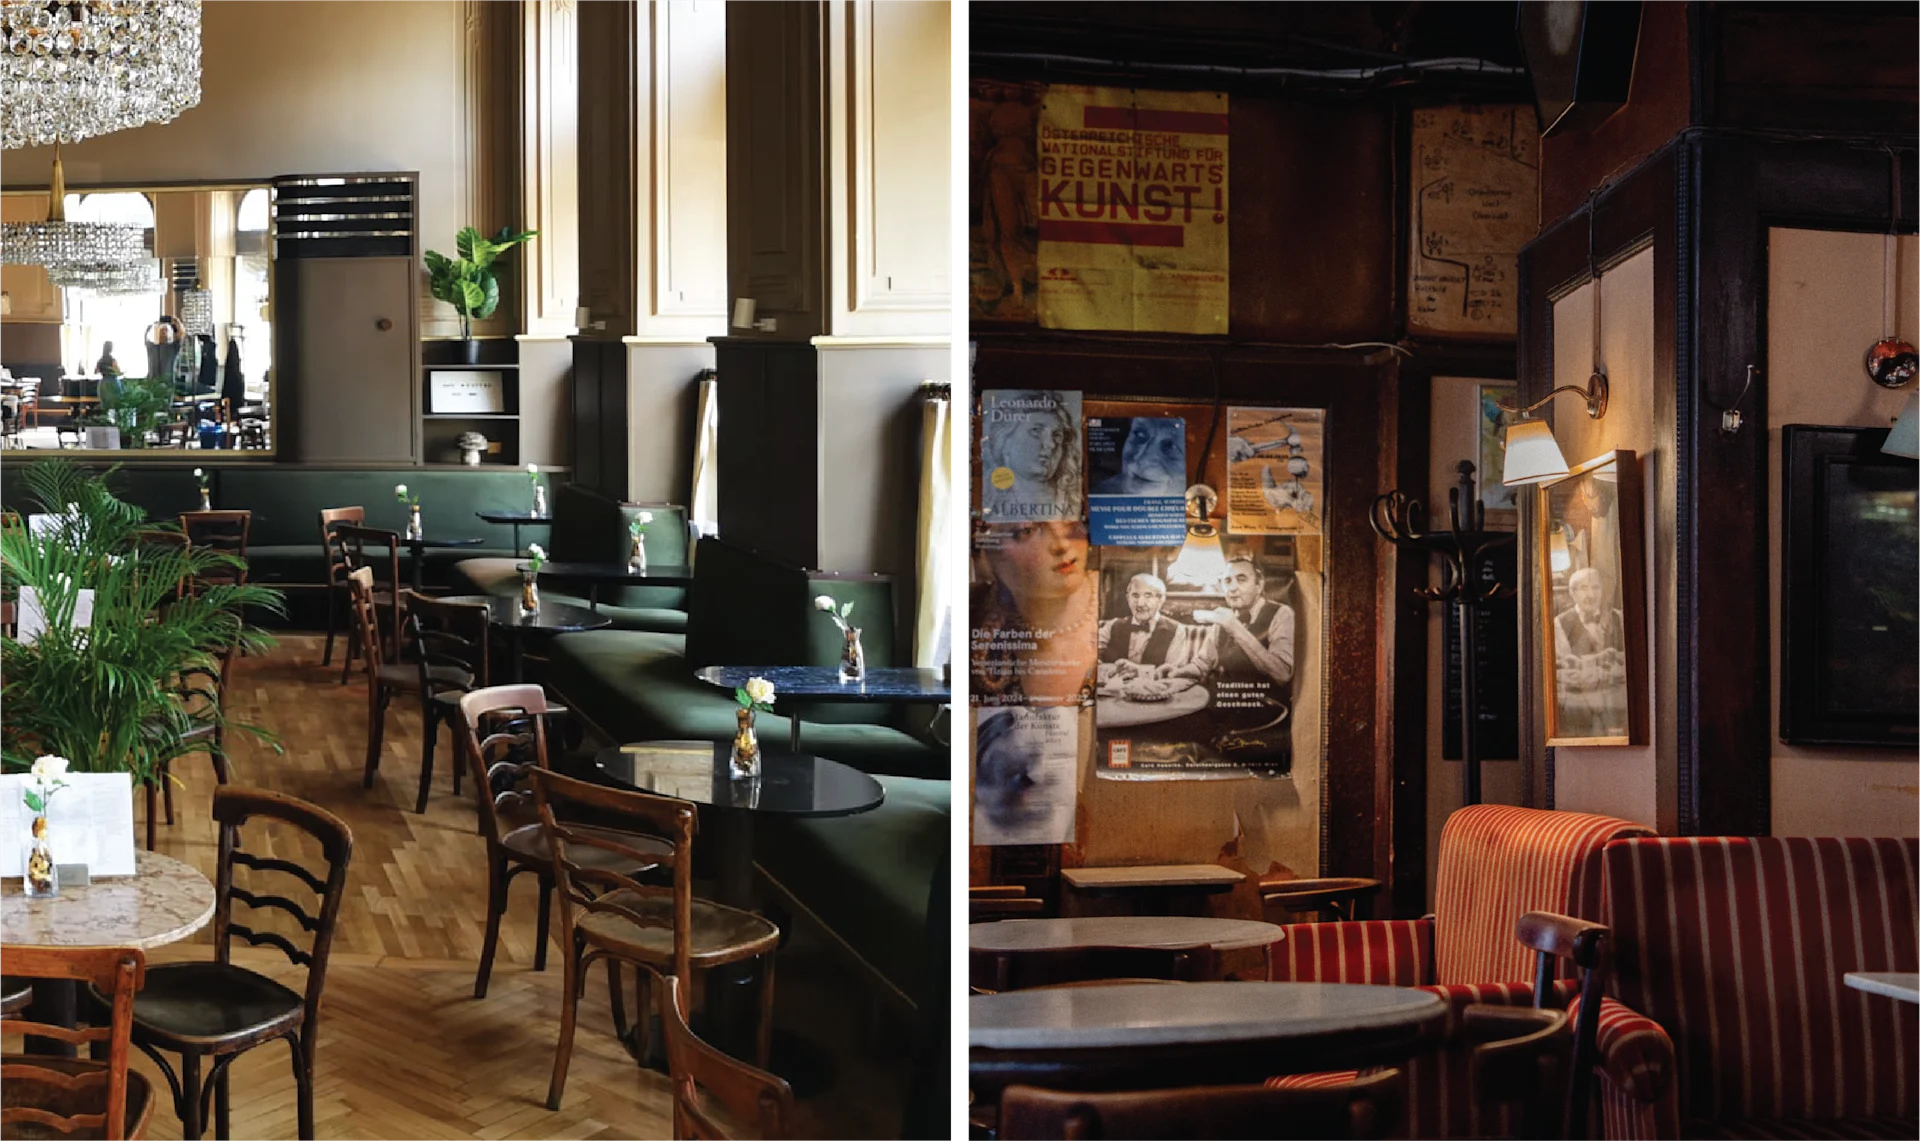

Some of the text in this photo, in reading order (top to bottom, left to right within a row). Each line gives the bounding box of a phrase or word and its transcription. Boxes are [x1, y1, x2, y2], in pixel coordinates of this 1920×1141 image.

[1042, 127, 1179, 147] ÖSTERREICHISCHE
[1042, 143, 1223, 161] NATIONALSTIFTUNG FÜR
[1041, 157, 1224, 185] GEGENWARTS
[991, 396, 1056, 409] Leonardo
[991, 410, 1032, 422] Dürer
[991, 504, 1075, 515] ALBERTINA
[971, 629, 1055, 639] Die Farben der
[971, 640, 1038, 650] Serenissima
